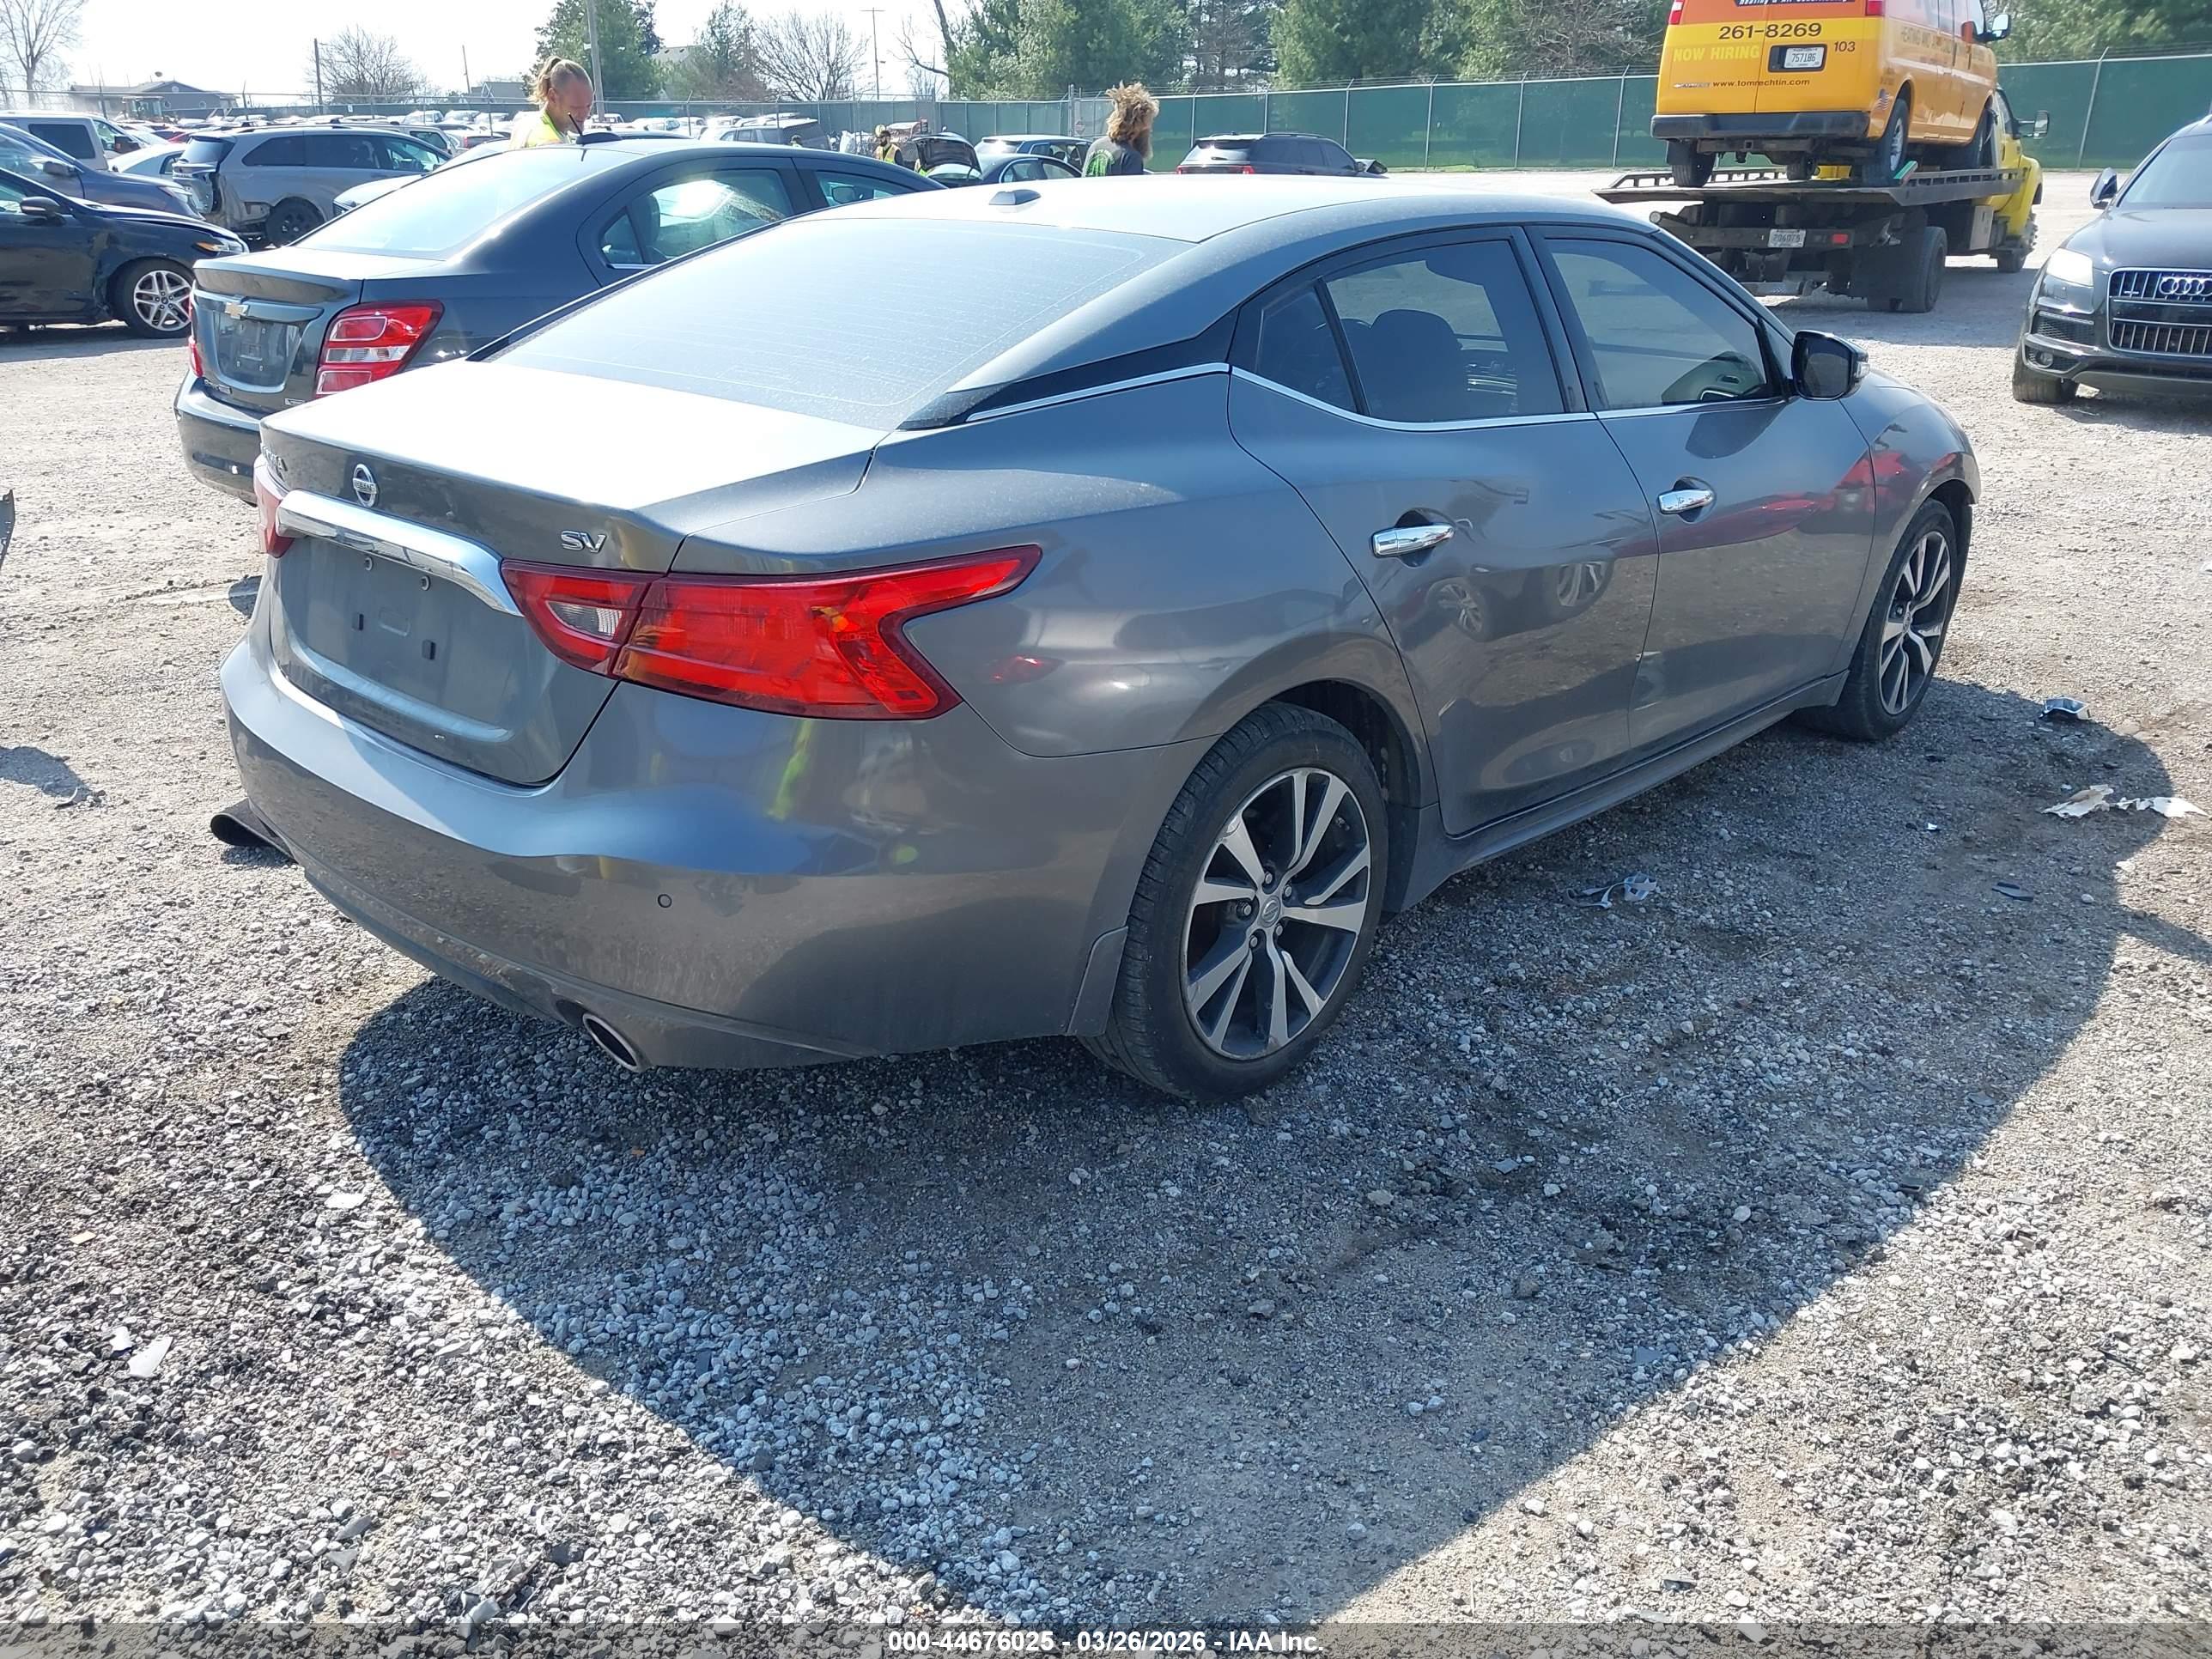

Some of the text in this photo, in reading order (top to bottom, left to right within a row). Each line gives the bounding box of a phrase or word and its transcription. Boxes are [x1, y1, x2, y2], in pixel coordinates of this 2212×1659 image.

[1718, 22, 1821, 40] 261-8269
[1674, 45, 1760, 62] NOW HIRING
[1834, 41, 1856, 52] 103
[1712, 78, 1810, 88] www.tomrechtin.com
[561, 530, 607, 553] SV
